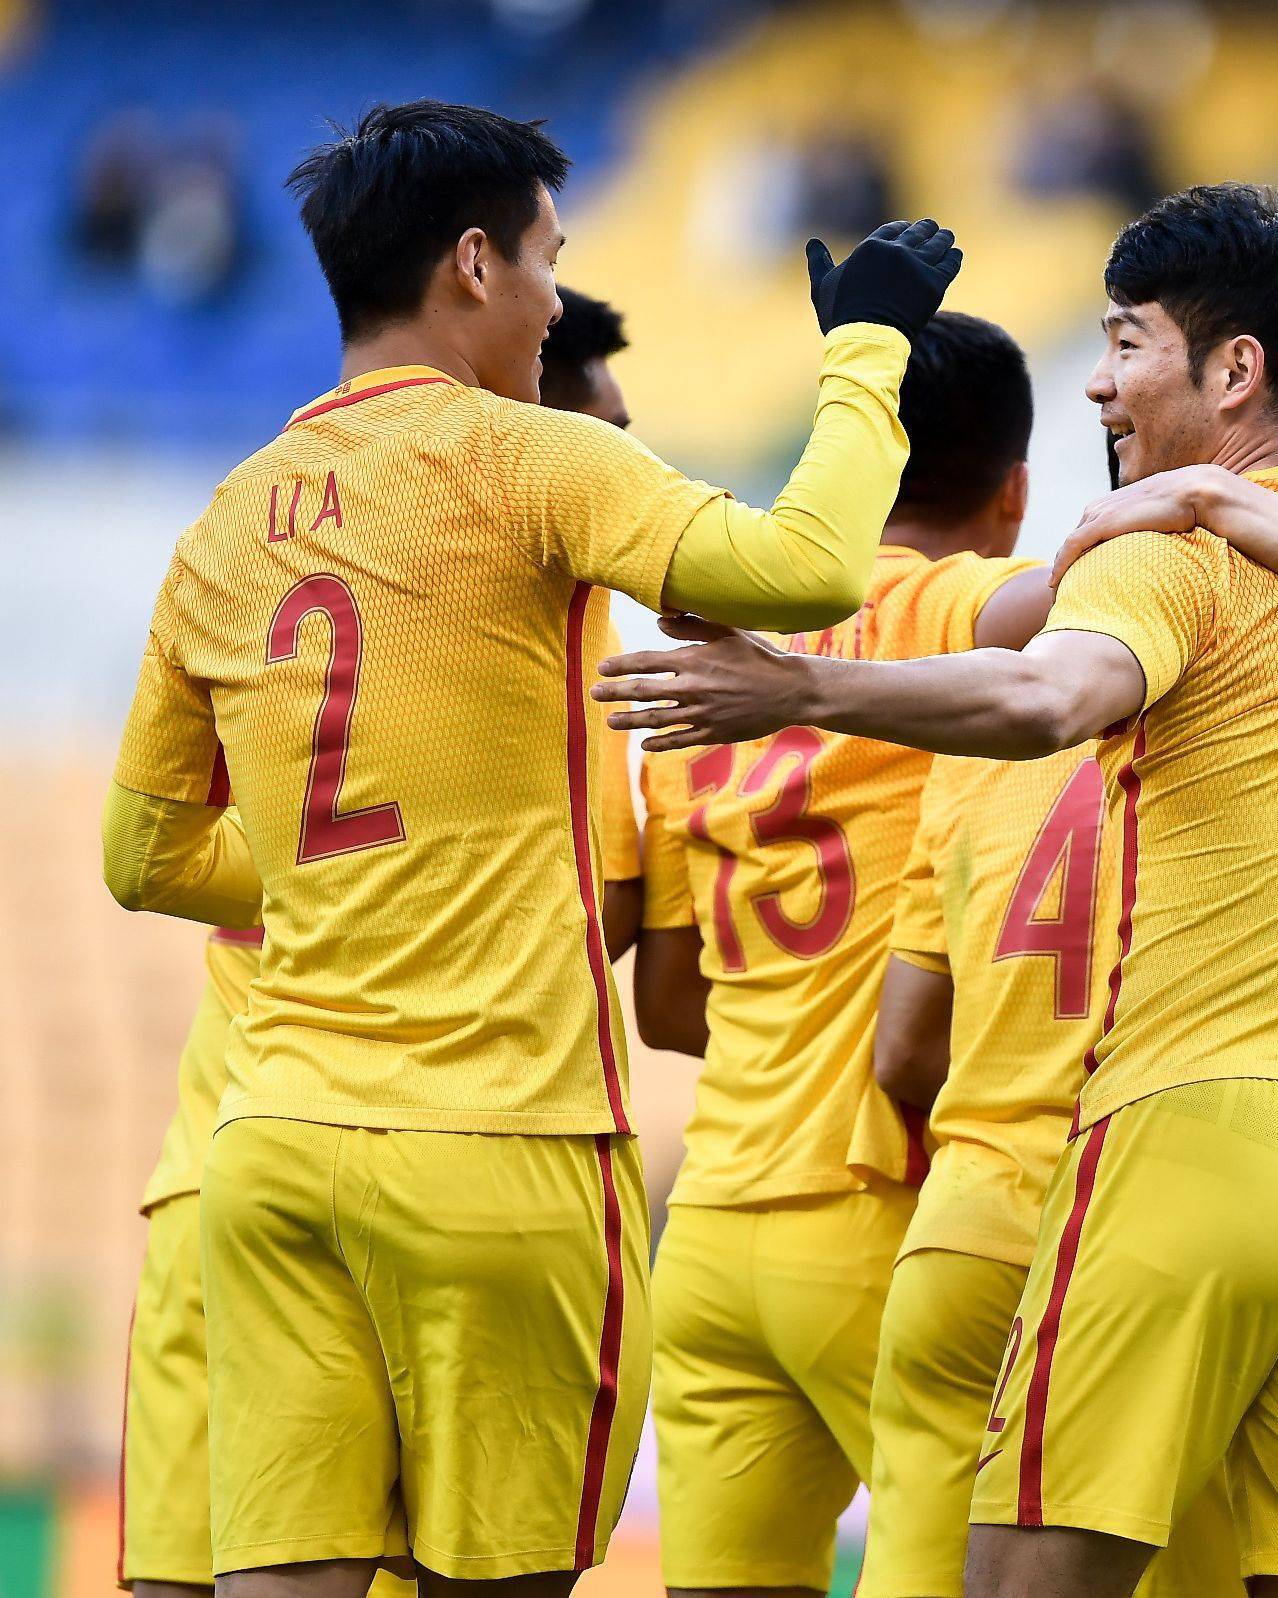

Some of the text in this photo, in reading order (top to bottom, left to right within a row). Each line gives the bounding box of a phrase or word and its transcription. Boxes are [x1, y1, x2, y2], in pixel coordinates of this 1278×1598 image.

[267, 471, 342, 543] LI A
[265, 572, 406, 866] 2
[686, 725, 856, 972] 13
[991, 756, 1107, 1020] 4
